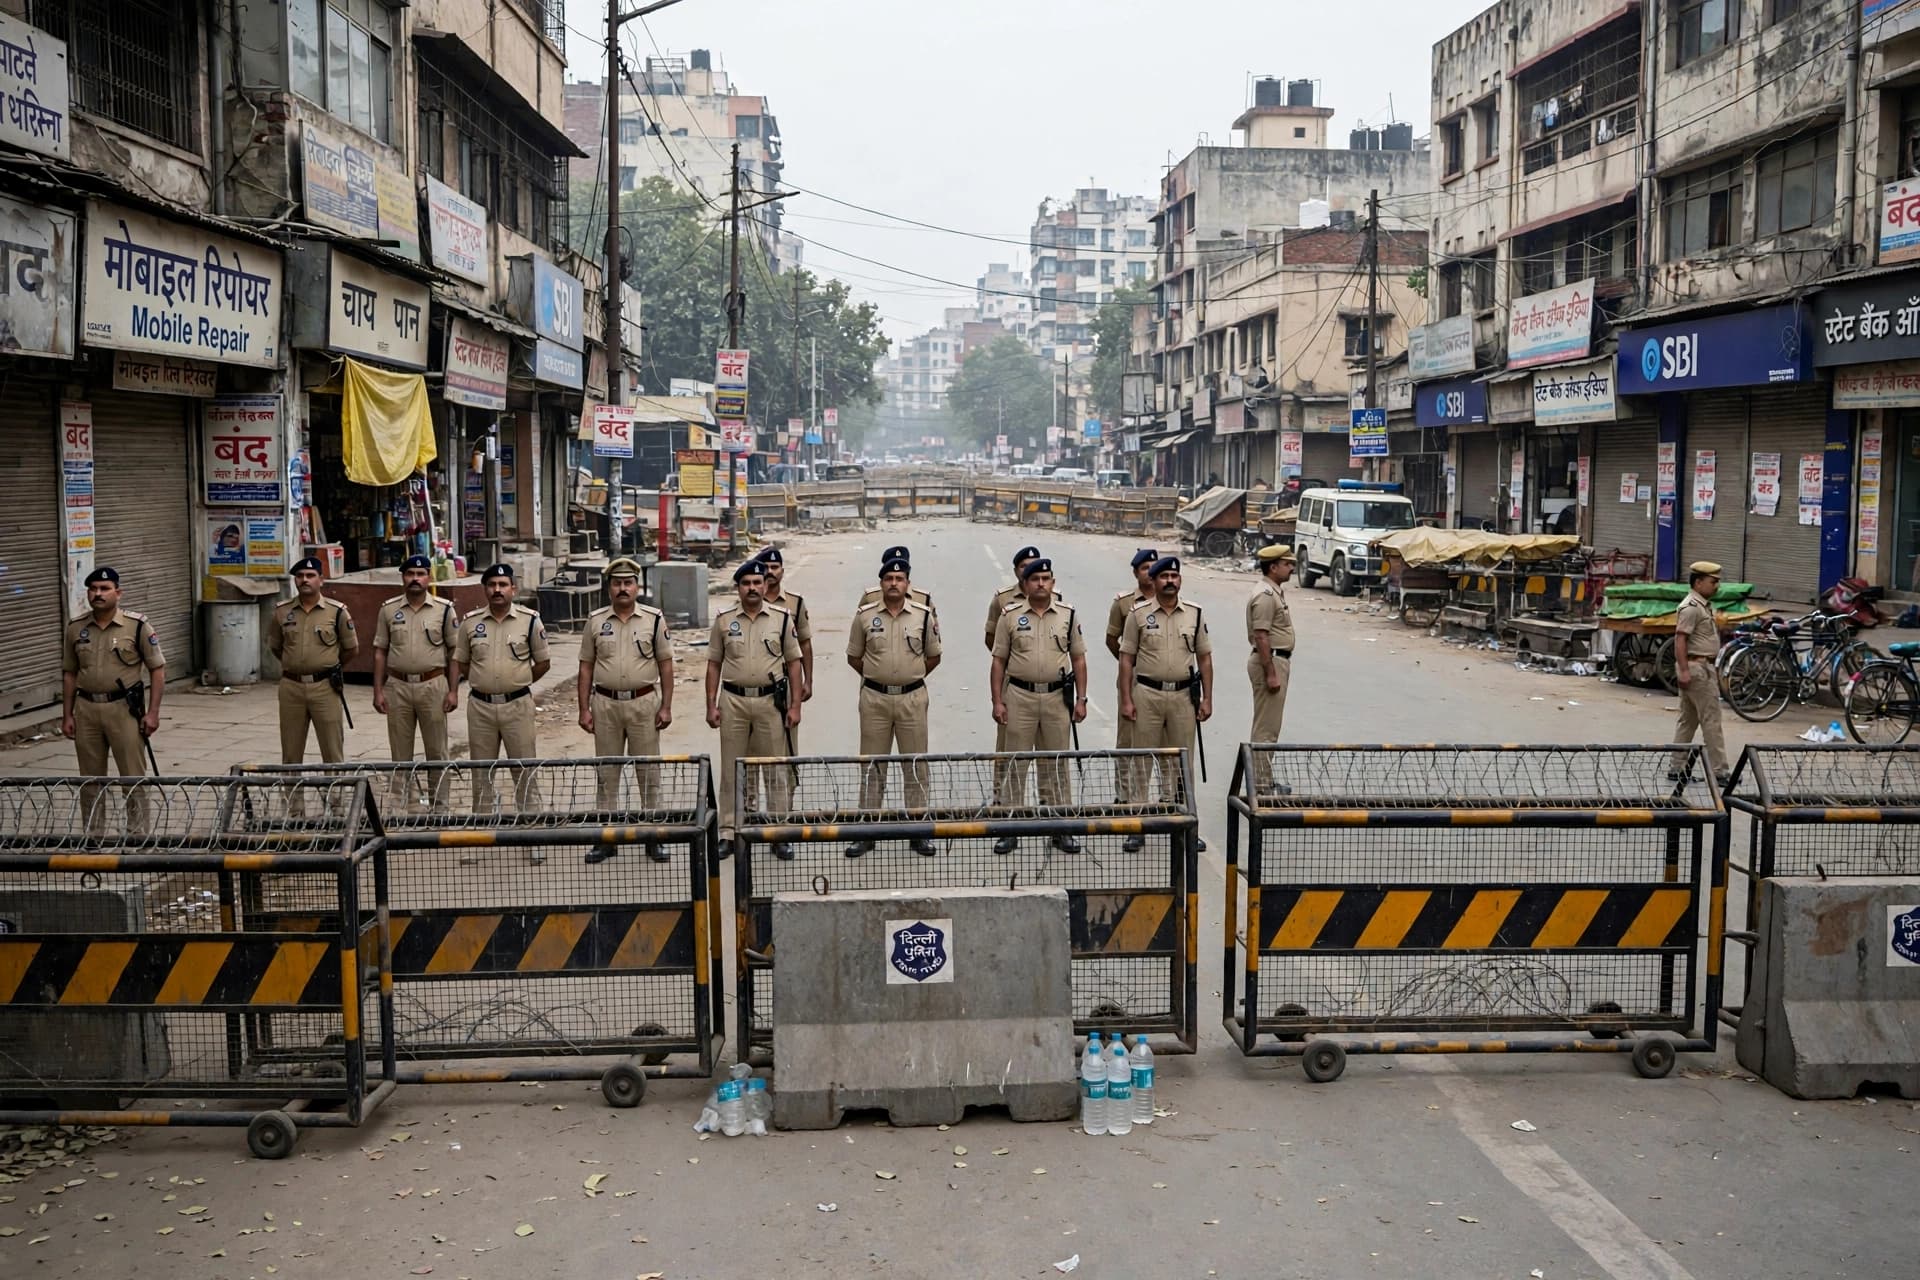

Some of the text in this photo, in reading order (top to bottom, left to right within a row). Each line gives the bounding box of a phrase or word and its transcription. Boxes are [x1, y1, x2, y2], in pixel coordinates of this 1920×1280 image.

[104, 219, 271, 318] मोबाइल रिपोयर
[132, 305, 192, 346] Mobile
[198, 316, 249, 356] Repair
[342, 281, 421, 342] चाय पान
[553, 278, 573, 339] SBI
[1662, 333, 1698, 380] SBI
[598, 414, 630, 440] बंद
[1446, 391, 1464, 418] SBI
[212, 426, 272, 468] बंद
